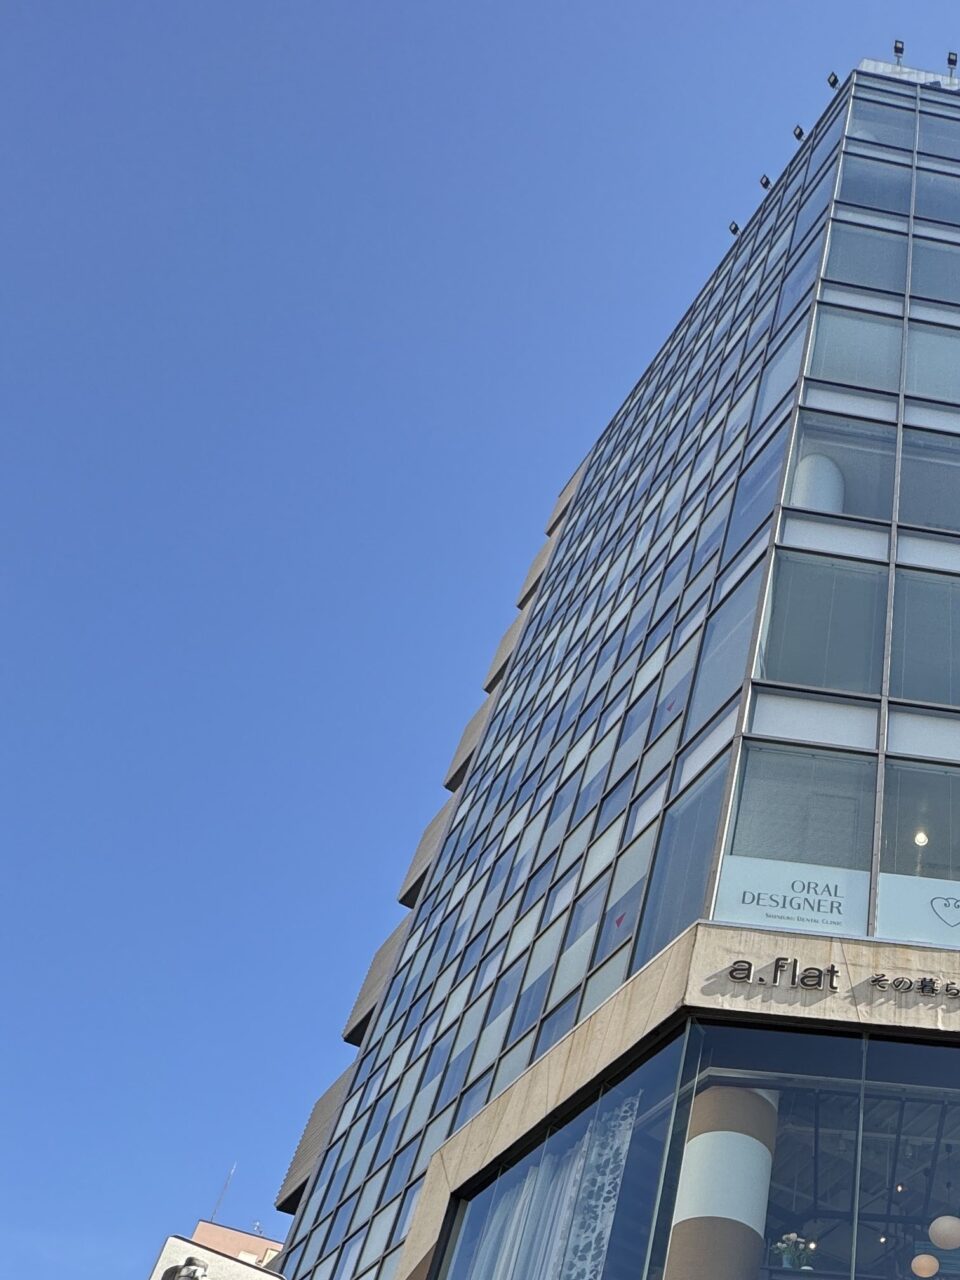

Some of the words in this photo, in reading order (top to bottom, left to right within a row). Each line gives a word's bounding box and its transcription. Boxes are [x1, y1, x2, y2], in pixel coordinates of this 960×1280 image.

[791, 880, 844, 898] ORAL
[741, 891, 843, 915] DESIGNER
[728, 956, 842, 994] a.flat
